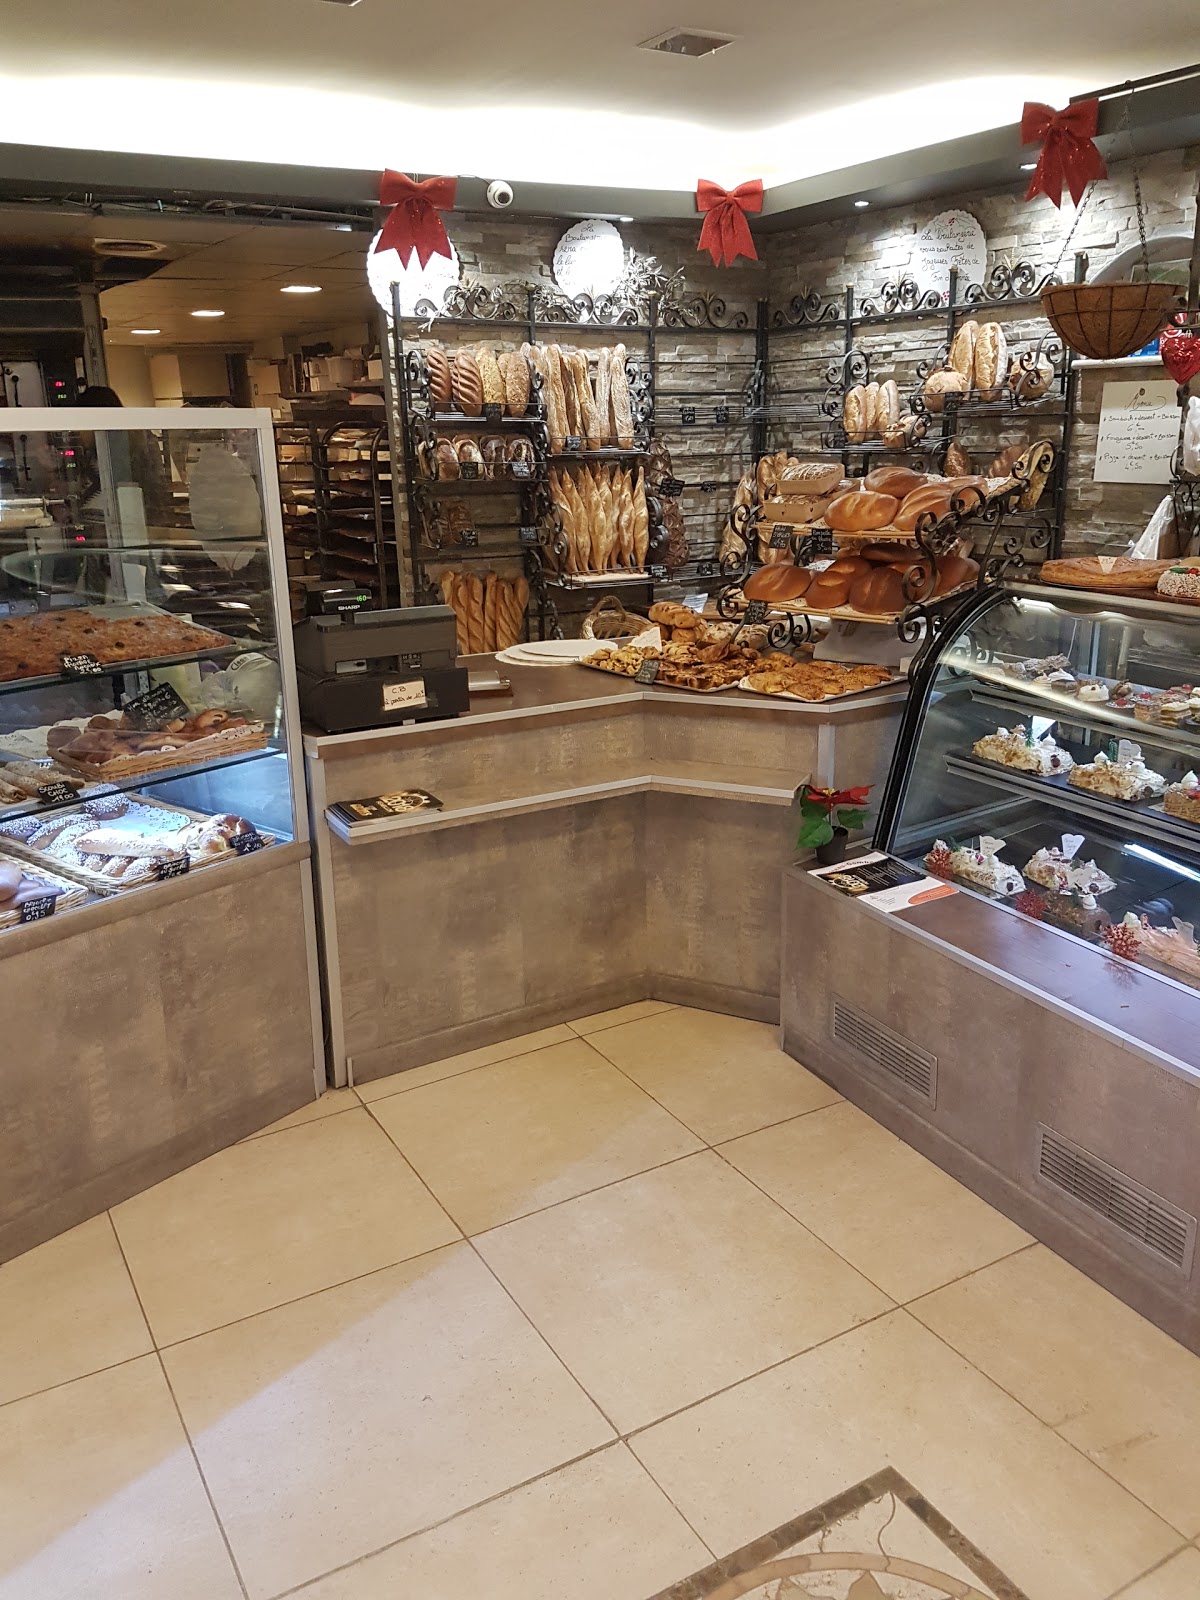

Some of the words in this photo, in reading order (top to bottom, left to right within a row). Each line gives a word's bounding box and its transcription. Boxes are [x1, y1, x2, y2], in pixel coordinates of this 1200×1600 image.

[921, 229, 933, 240] La
[967, 242, 975, 250] de
[972, 255, 980, 264] de
[391, 696, 406, 706] partir
[48, 788, 68, 797] CHOC
